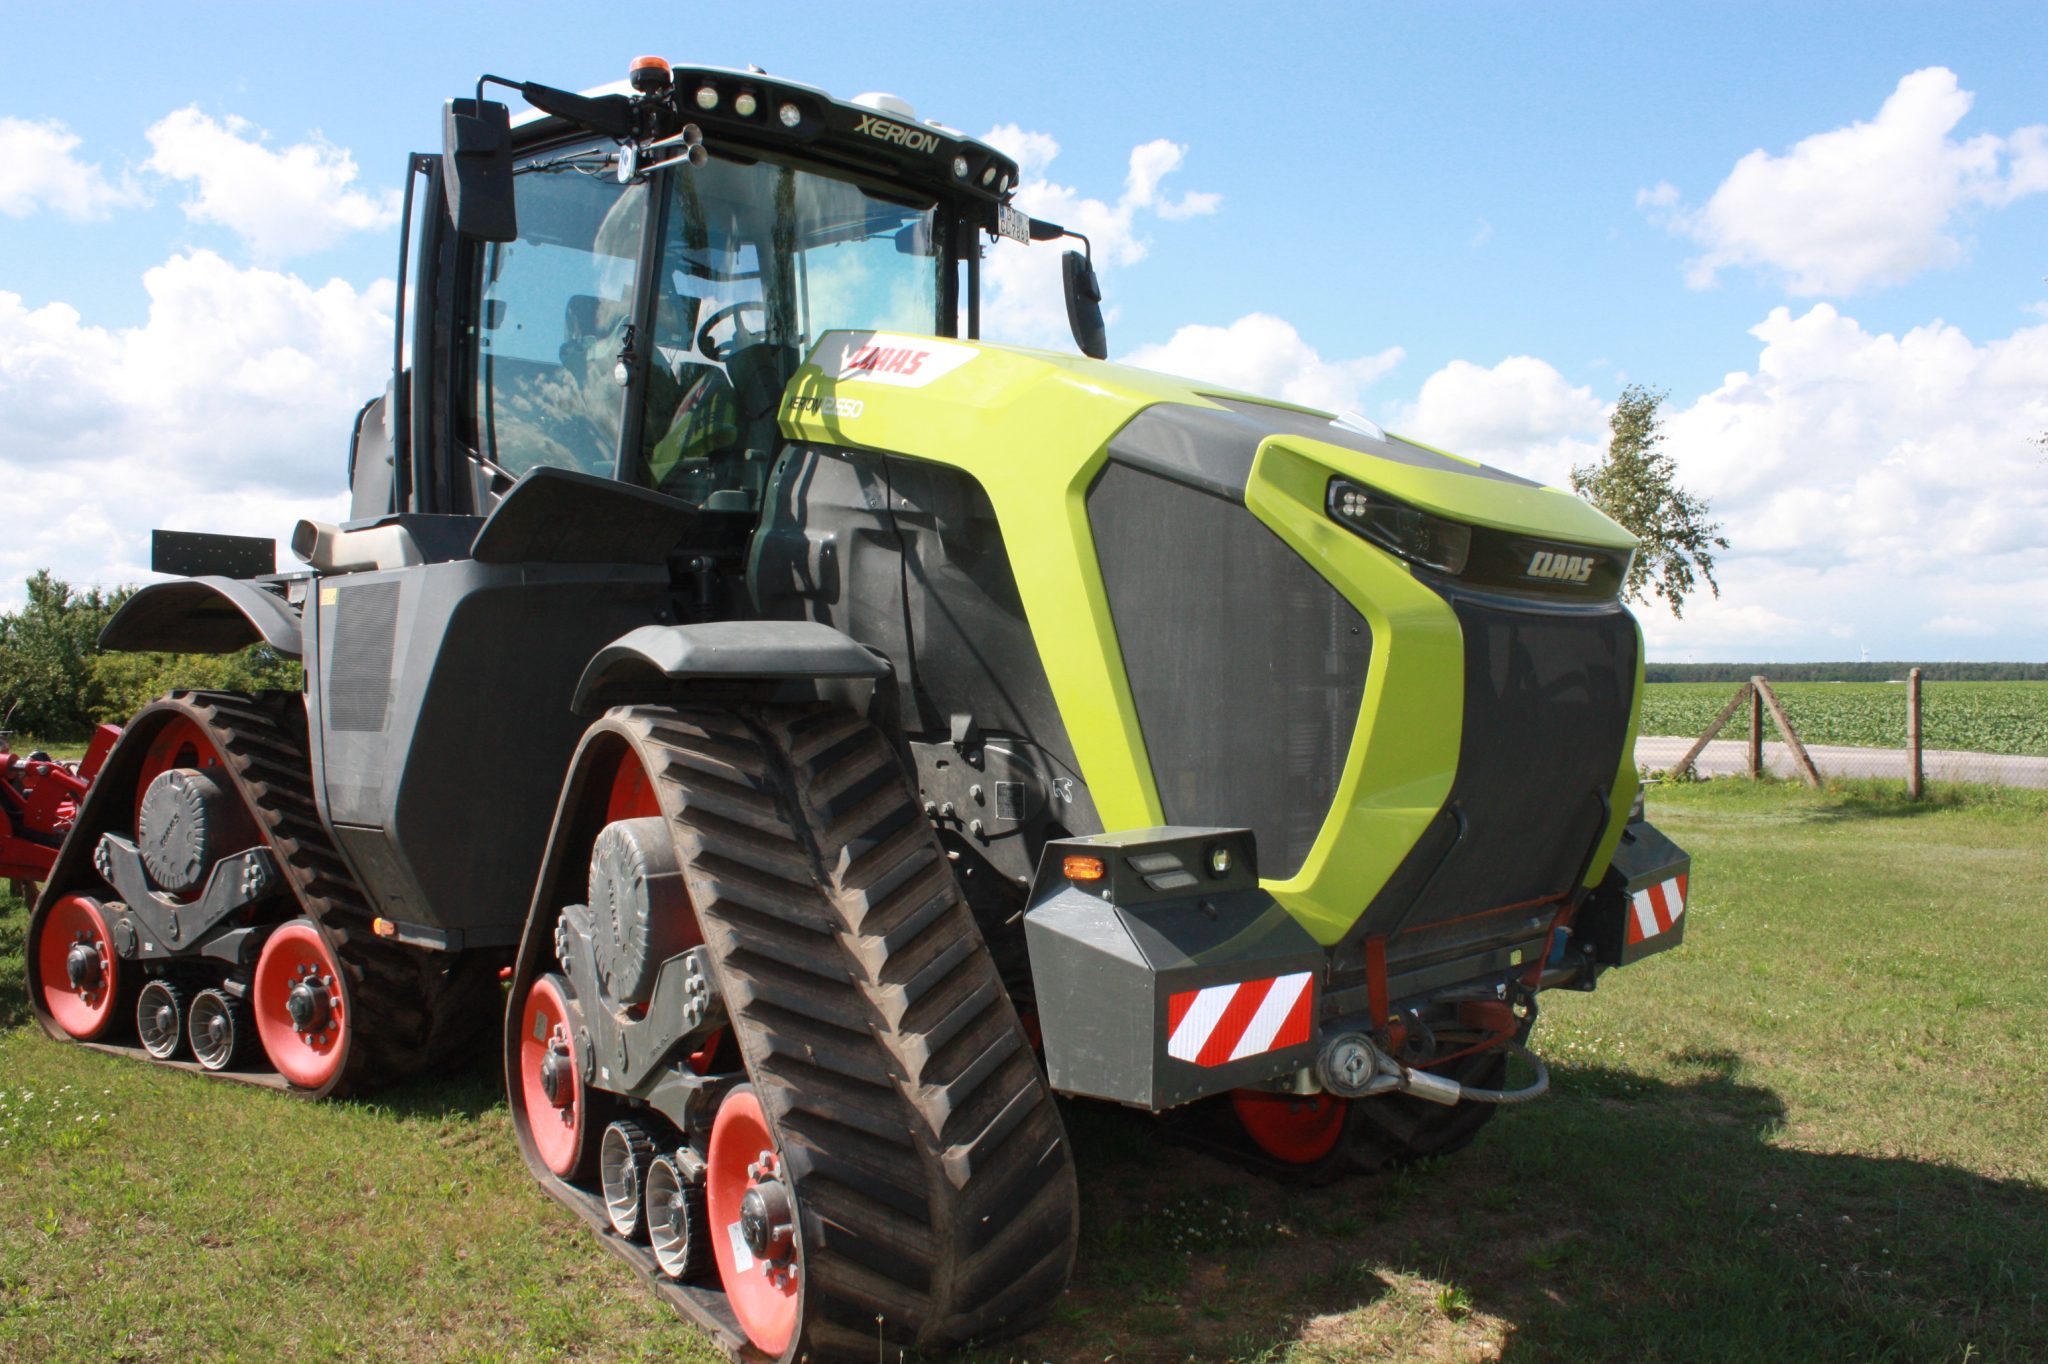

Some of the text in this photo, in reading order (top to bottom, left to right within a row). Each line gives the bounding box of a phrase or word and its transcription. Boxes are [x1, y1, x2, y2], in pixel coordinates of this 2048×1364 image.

[854, 114, 940, 154] XERION
[848, 345, 931, 376] CLAAS
[1527, 551, 1595, 582] CLAAS
